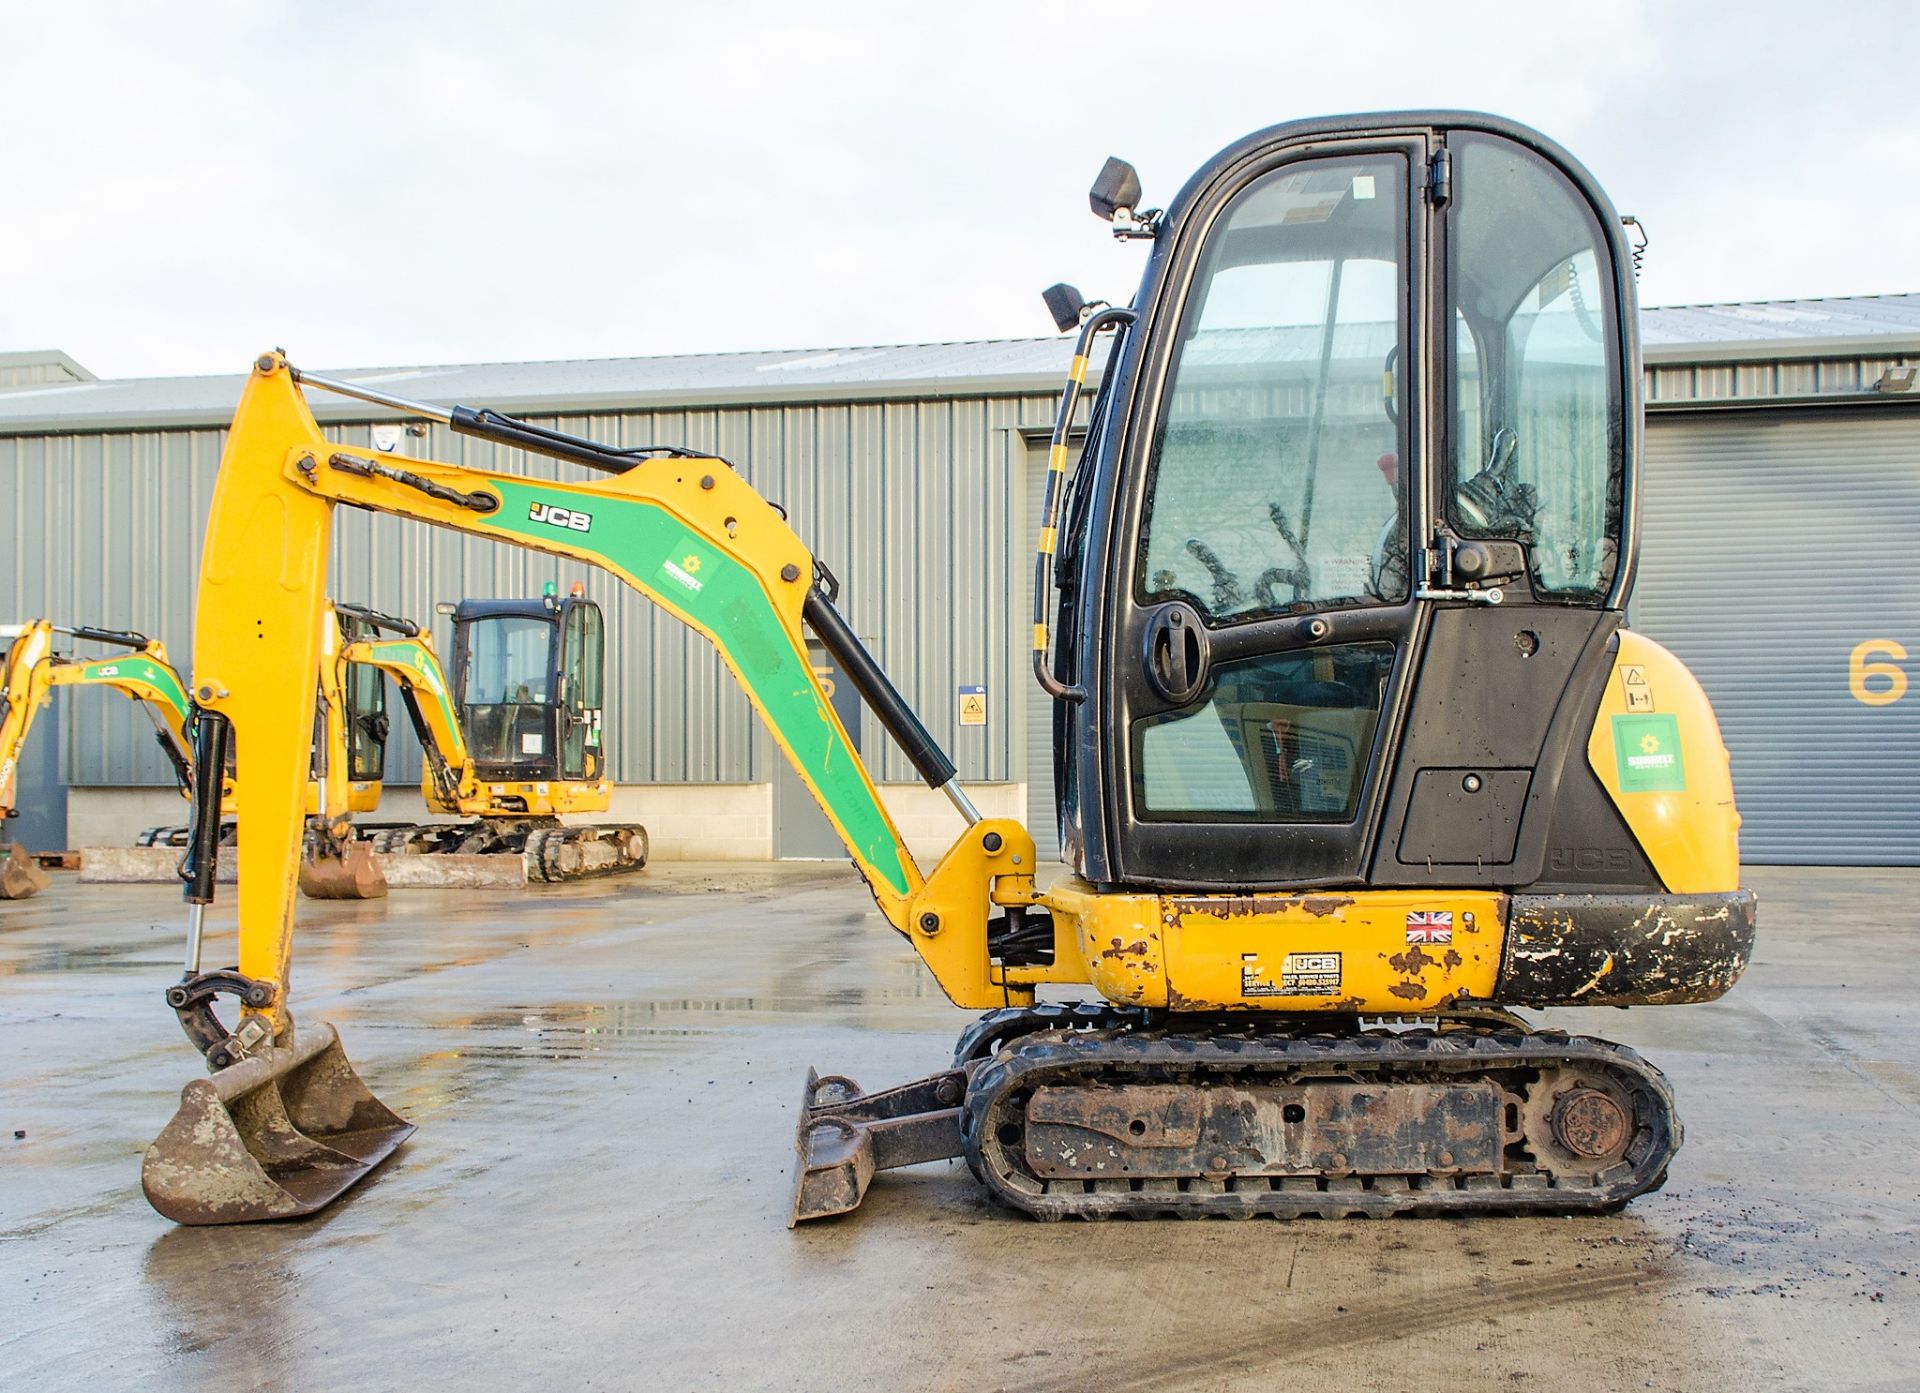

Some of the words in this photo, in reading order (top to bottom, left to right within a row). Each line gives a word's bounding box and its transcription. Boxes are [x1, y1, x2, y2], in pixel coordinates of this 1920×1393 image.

[529, 503, 592, 533] JCB
[1849, 639, 1909, 706] 6
[1551, 847, 1633, 872] JCB
[1296, 958, 1337, 970] JCB
